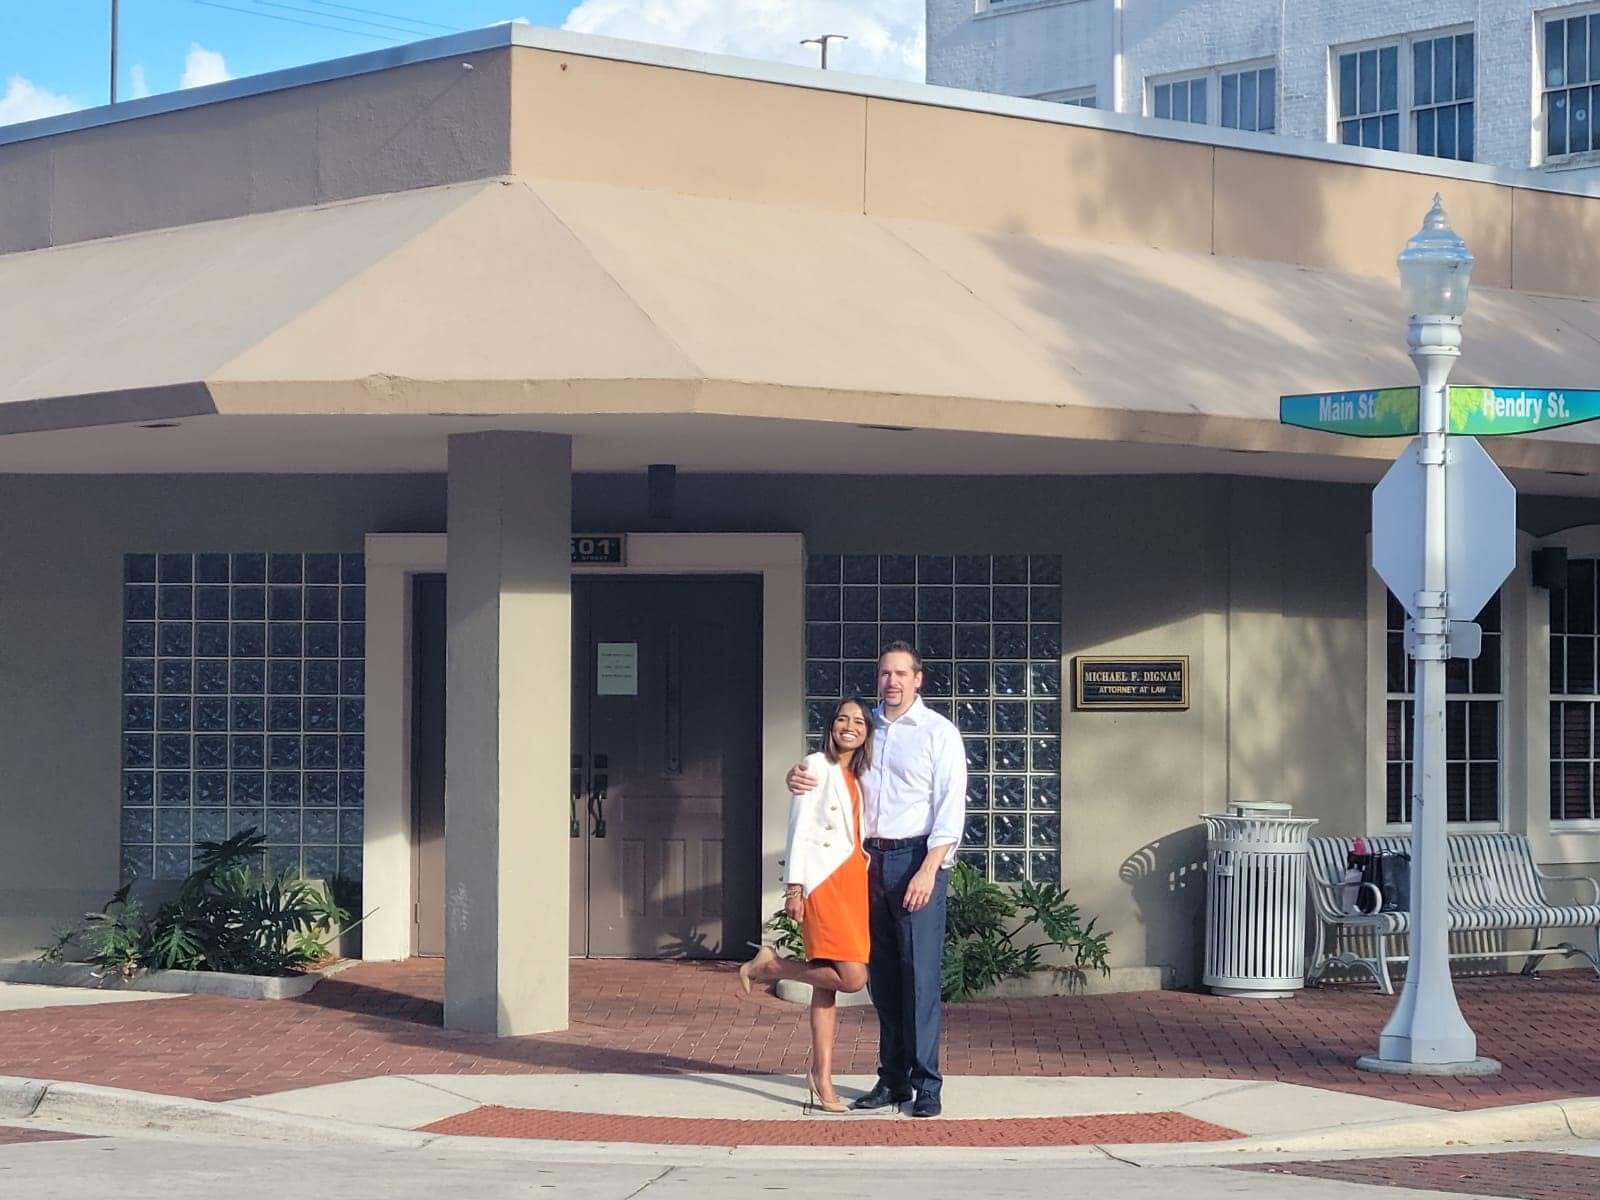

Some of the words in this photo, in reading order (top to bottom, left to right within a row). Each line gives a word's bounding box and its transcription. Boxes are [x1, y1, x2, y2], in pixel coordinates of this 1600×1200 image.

[1319, 395, 1354, 421] Main
[1482, 389, 1543, 424] Hendry
[1547, 391, 1570, 418] St.
[1085, 671, 1128, 682] MICHAEL
[1131, 671, 1140, 682] F.
[1144, 671, 1181, 682] DIGNAM
[1099, 685, 1137, 694] ATTORNEY
[1139, 685, 1149, 694] AT
[1151, 685, 1167, 694] LAW
